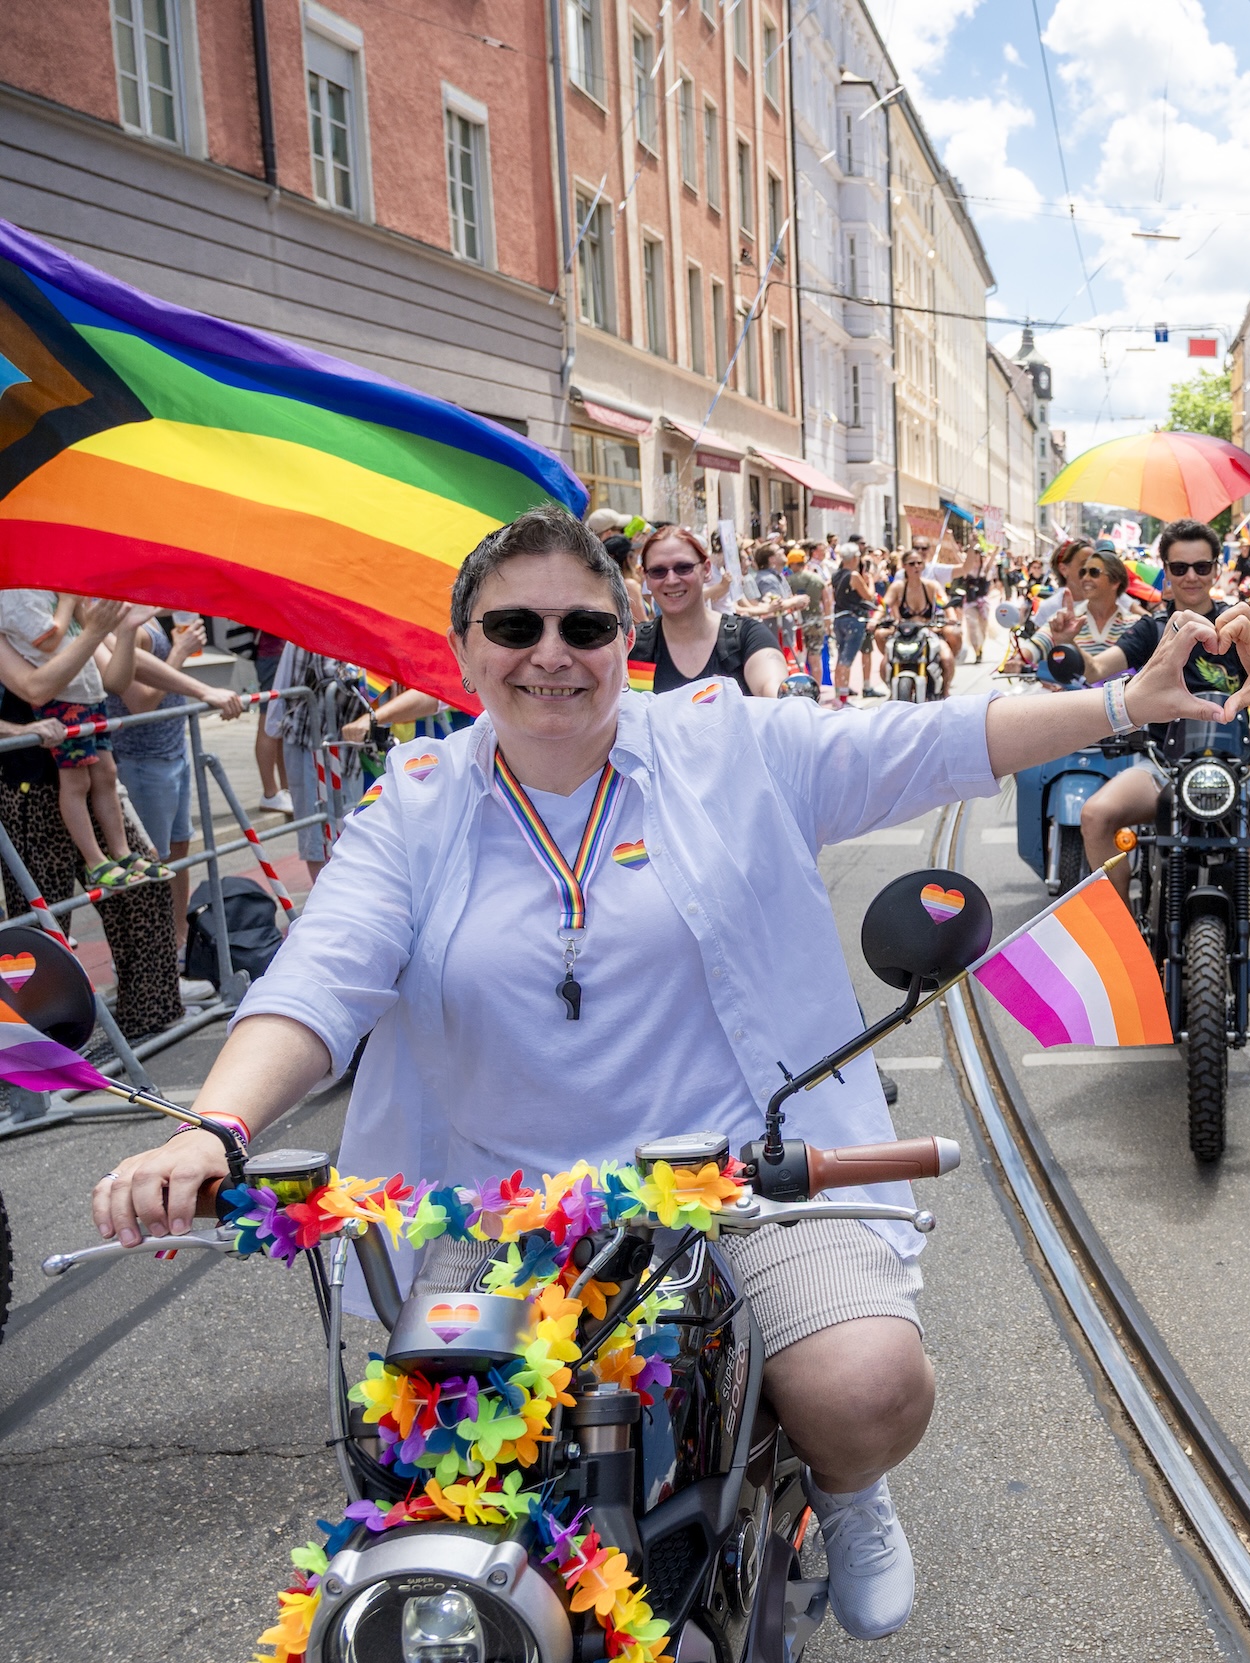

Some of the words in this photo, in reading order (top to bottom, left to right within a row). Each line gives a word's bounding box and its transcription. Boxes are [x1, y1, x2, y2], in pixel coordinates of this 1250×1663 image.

[722, 1346, 736, 1400] SUPER
[726, 1341, 746, 1437] SOCO
[398, 1583, 445, 1592] SOCO
